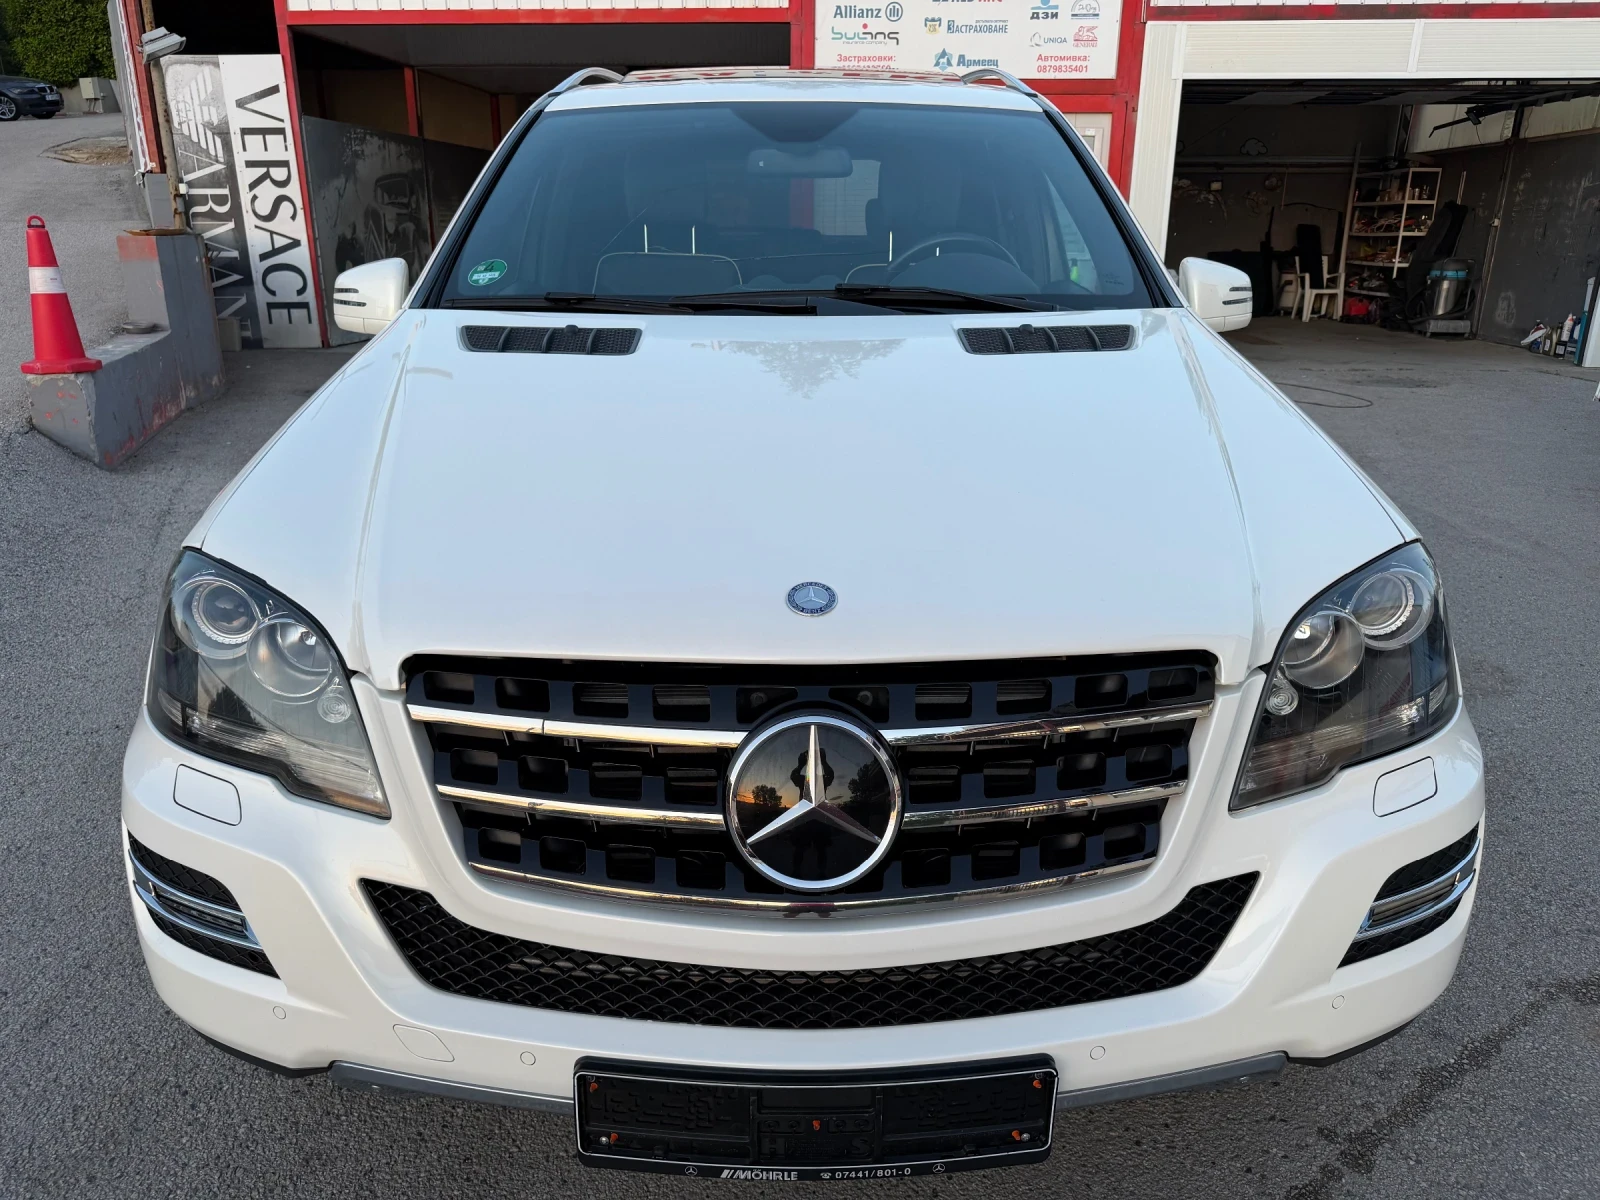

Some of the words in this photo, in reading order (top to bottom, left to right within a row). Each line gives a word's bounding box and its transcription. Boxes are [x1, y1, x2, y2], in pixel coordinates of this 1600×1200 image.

[833, 5, 882, 18] Allianz
[1030, 11, 1059, 20] ДЗИ
[837, 53, 896, 64] Застраховки:
[956, 54, 999, 68] Армеец
[1036, 53, 1090, 62] Автомивка:
[1036, 64, 1088, 73] 0879835401
[235, 83, 312, 325] VERSACE
[835, 1167, 911, 1179] 07441/801-0
